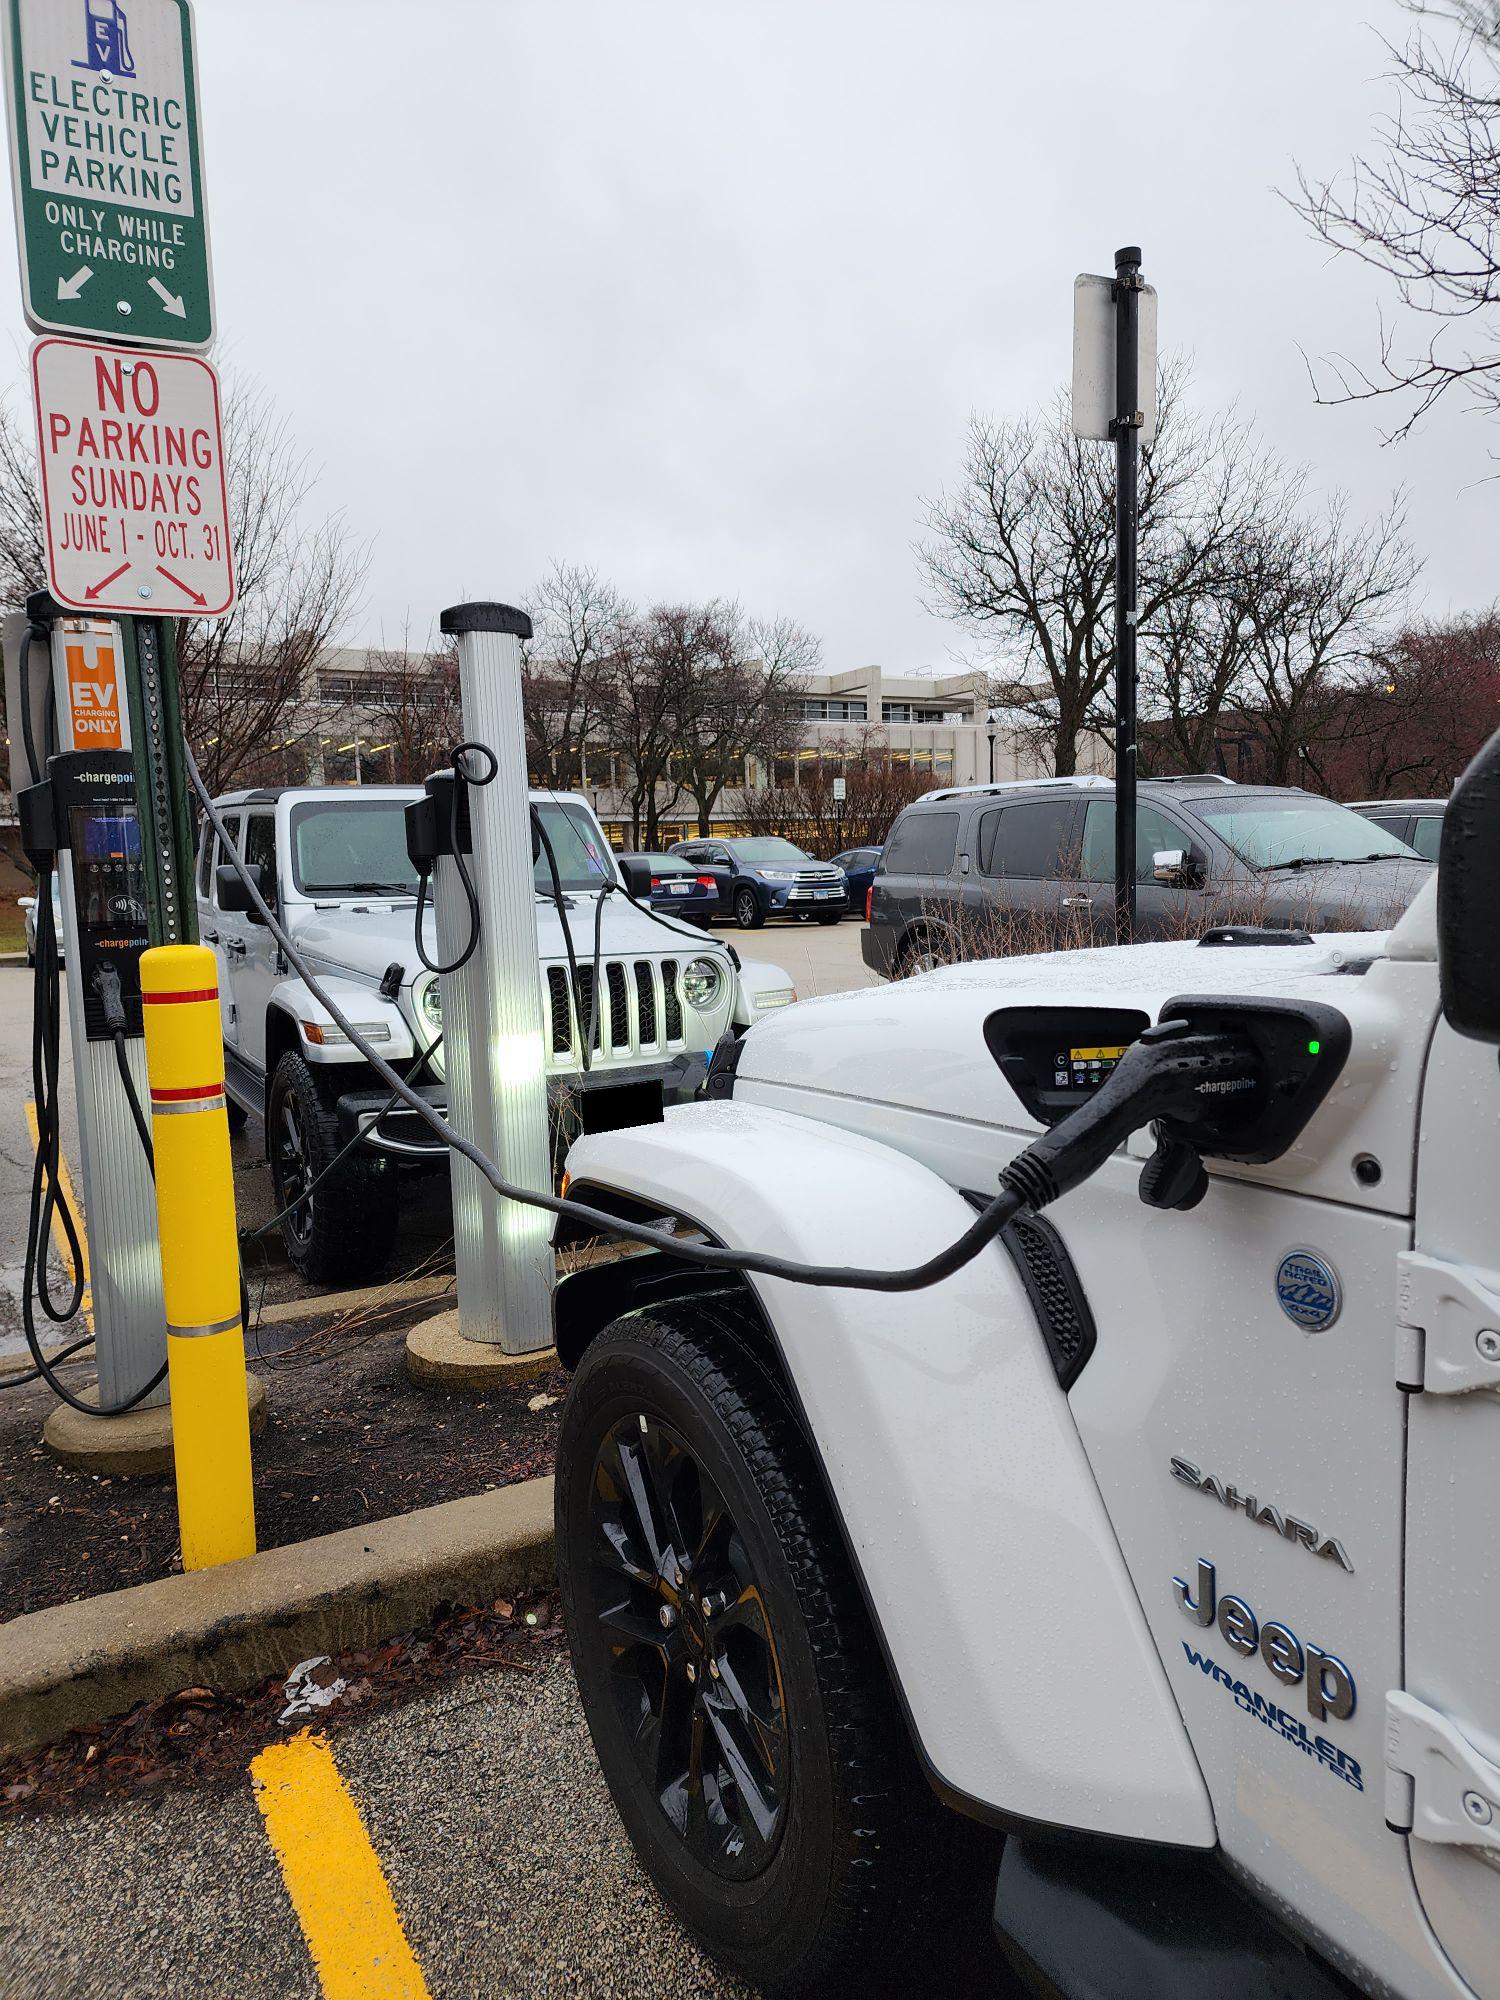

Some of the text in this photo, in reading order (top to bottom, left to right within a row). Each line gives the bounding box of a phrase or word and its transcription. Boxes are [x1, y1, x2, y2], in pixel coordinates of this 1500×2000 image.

[30, 70, 182, 130] ELECTRIC
[40, 110, 178, 166] VEHICLE
[40, 149, 182, 204] PARKING
[45, 201, 186, 246] ONLY WHILE
[60, 230, 175, 269] CHARGING
[94, 355, 160, 417] NO
[49, 412, 212, 469] PARKING
[70, 464, 202, 516] SUNDAYS
[60, 512, 111, 553] JUNE
[119, 517, 128, 554] 1
[154, 520, 195, 559] OCT.
[202, 524, 221, 561] 31
[72, 682, 115, 708] EV
[74, 709, 116, 718] CHARGING
[75, 719, 118, 734] ONLY
[80, 772, 135, 785] chargepoi
[1284, 1270, 1327, 1286] RATED
[1287, 1263, 1322, 1277] TRAIL
[1170, 1455, 1355, 1573] SAHARA
[1172, 1557, 1357, 1724] Jeep
[1181, 1640, 1364, 1785] WRANGLER
[1234, 1694, 1364, 1792] UNLIMITED
